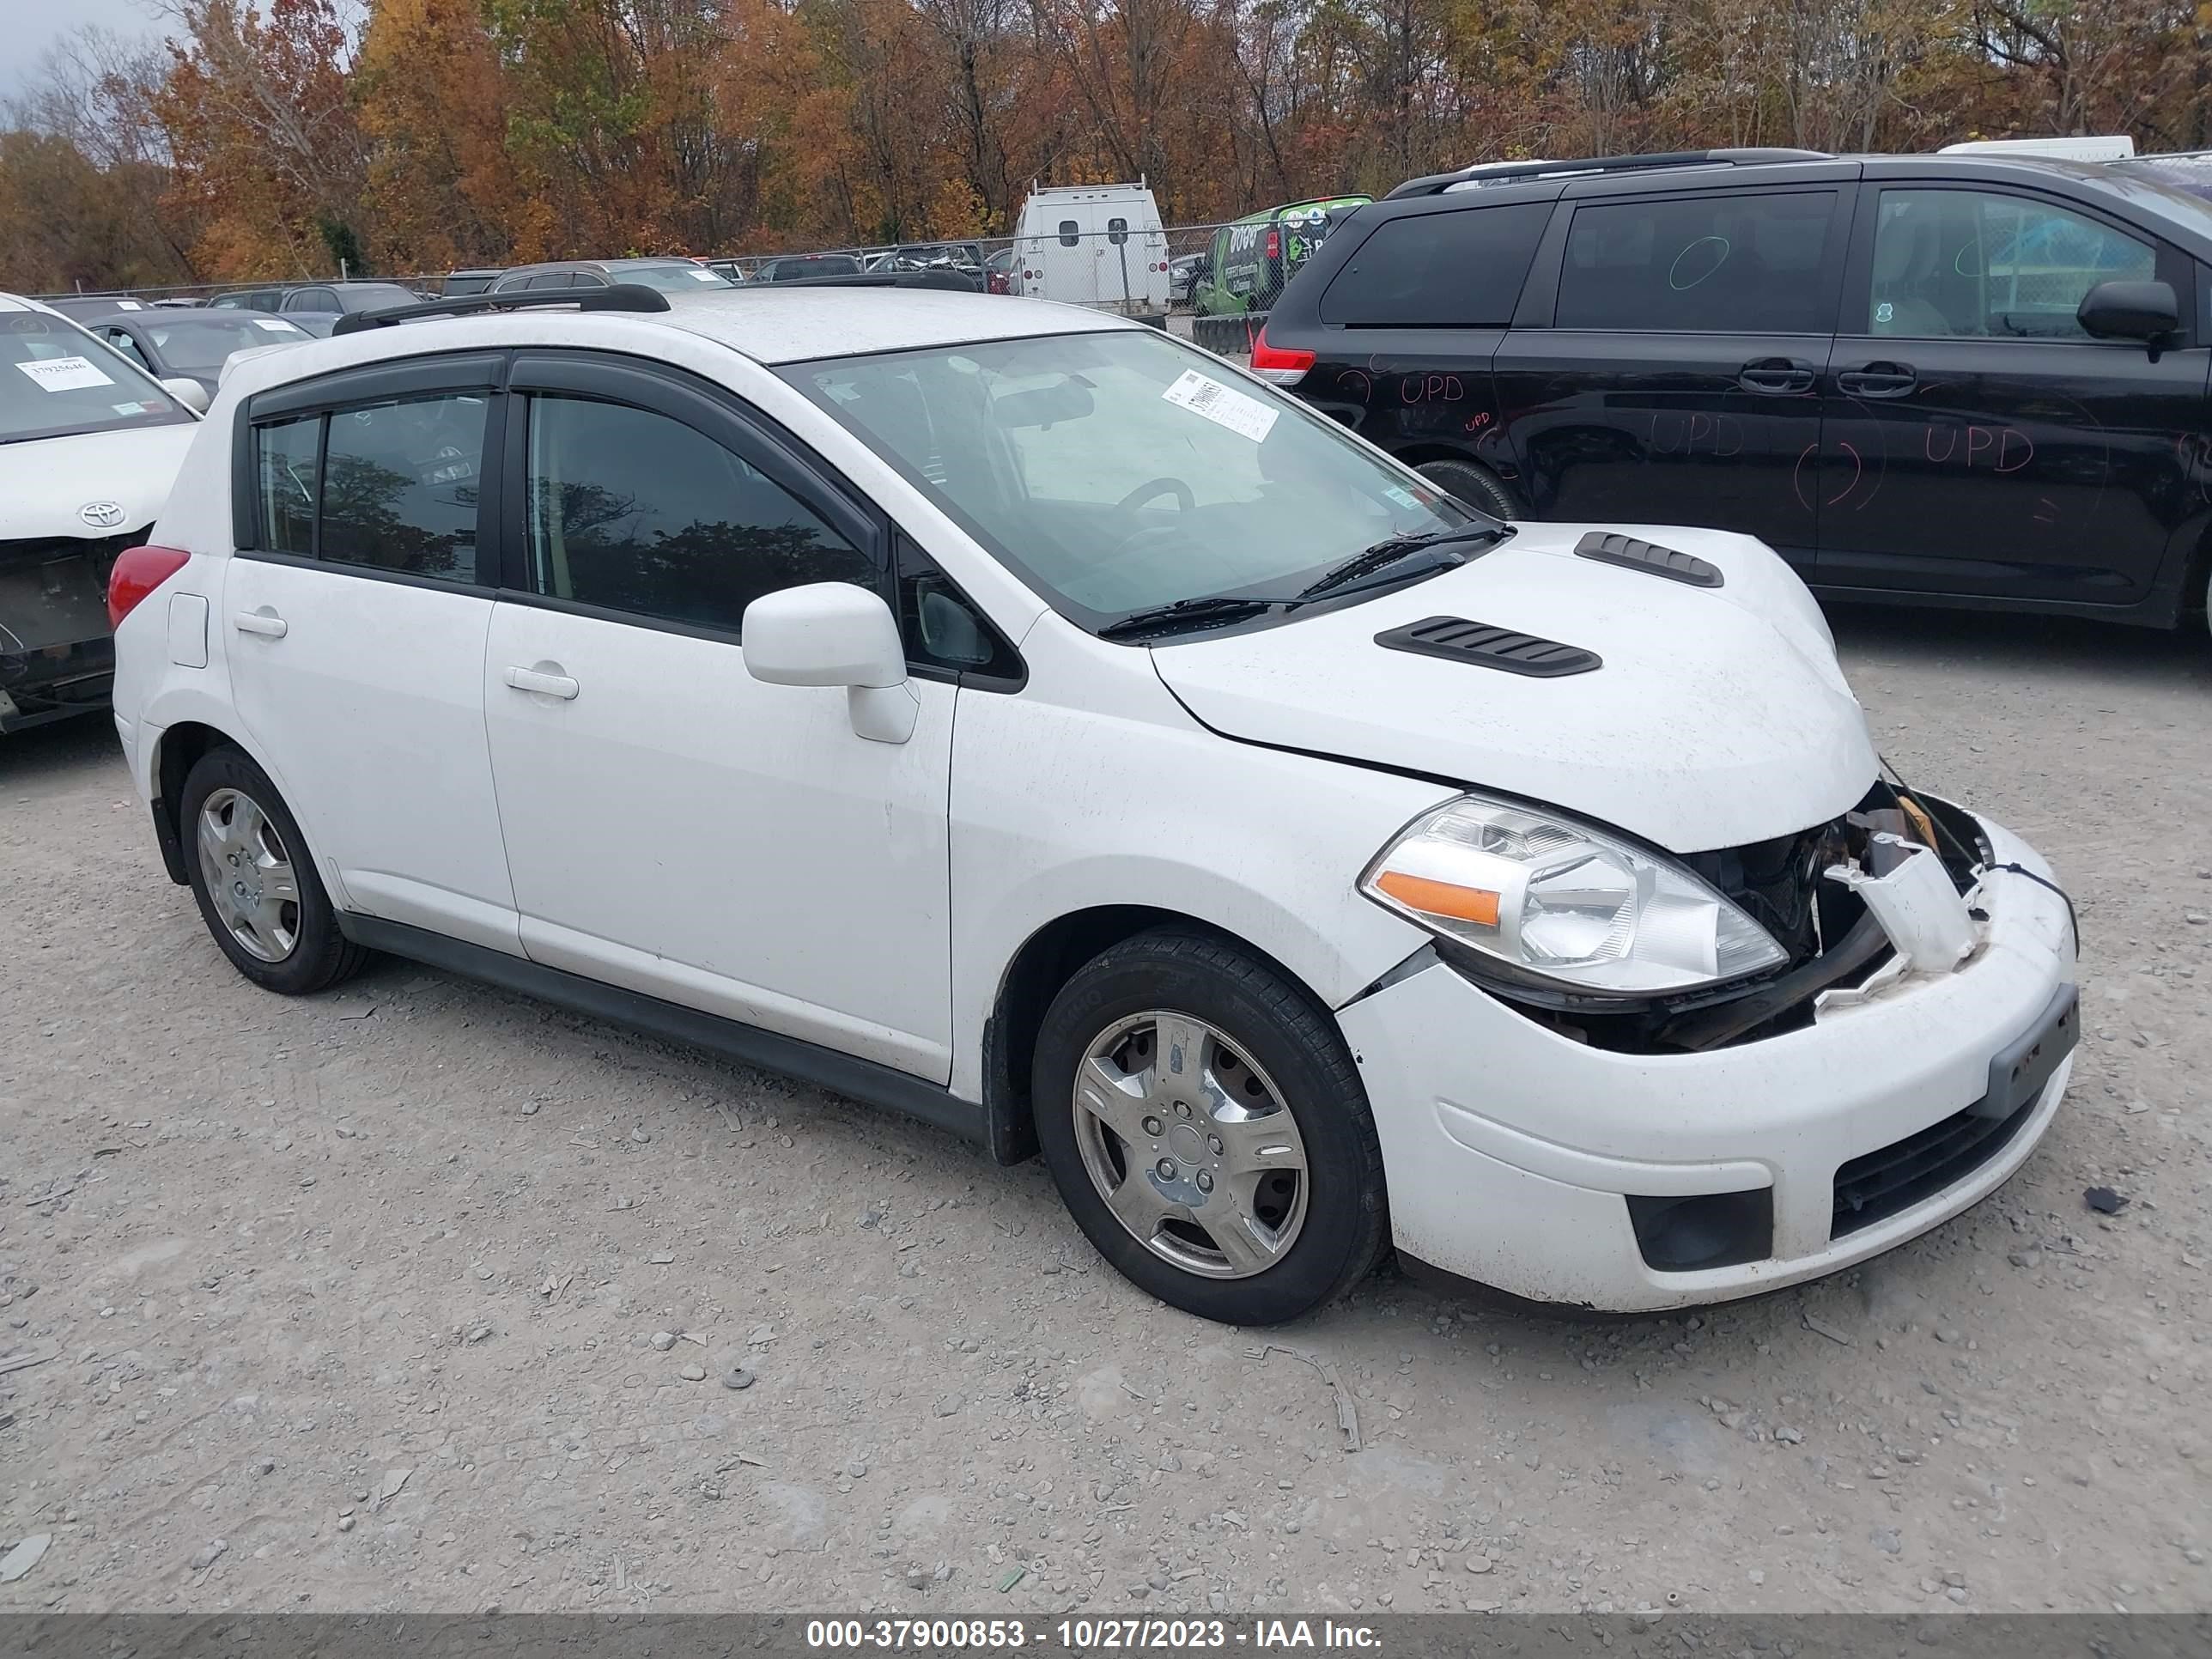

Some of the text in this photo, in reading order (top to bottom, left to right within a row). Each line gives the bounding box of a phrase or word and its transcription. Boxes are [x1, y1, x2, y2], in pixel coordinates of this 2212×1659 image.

[1401, 374, 1464, 405] UPD
[1464, 411, 1490, 434] UPD
[1650, 412, 1744, 458] UPD
[1925, 426, 2035, 472] UPD
